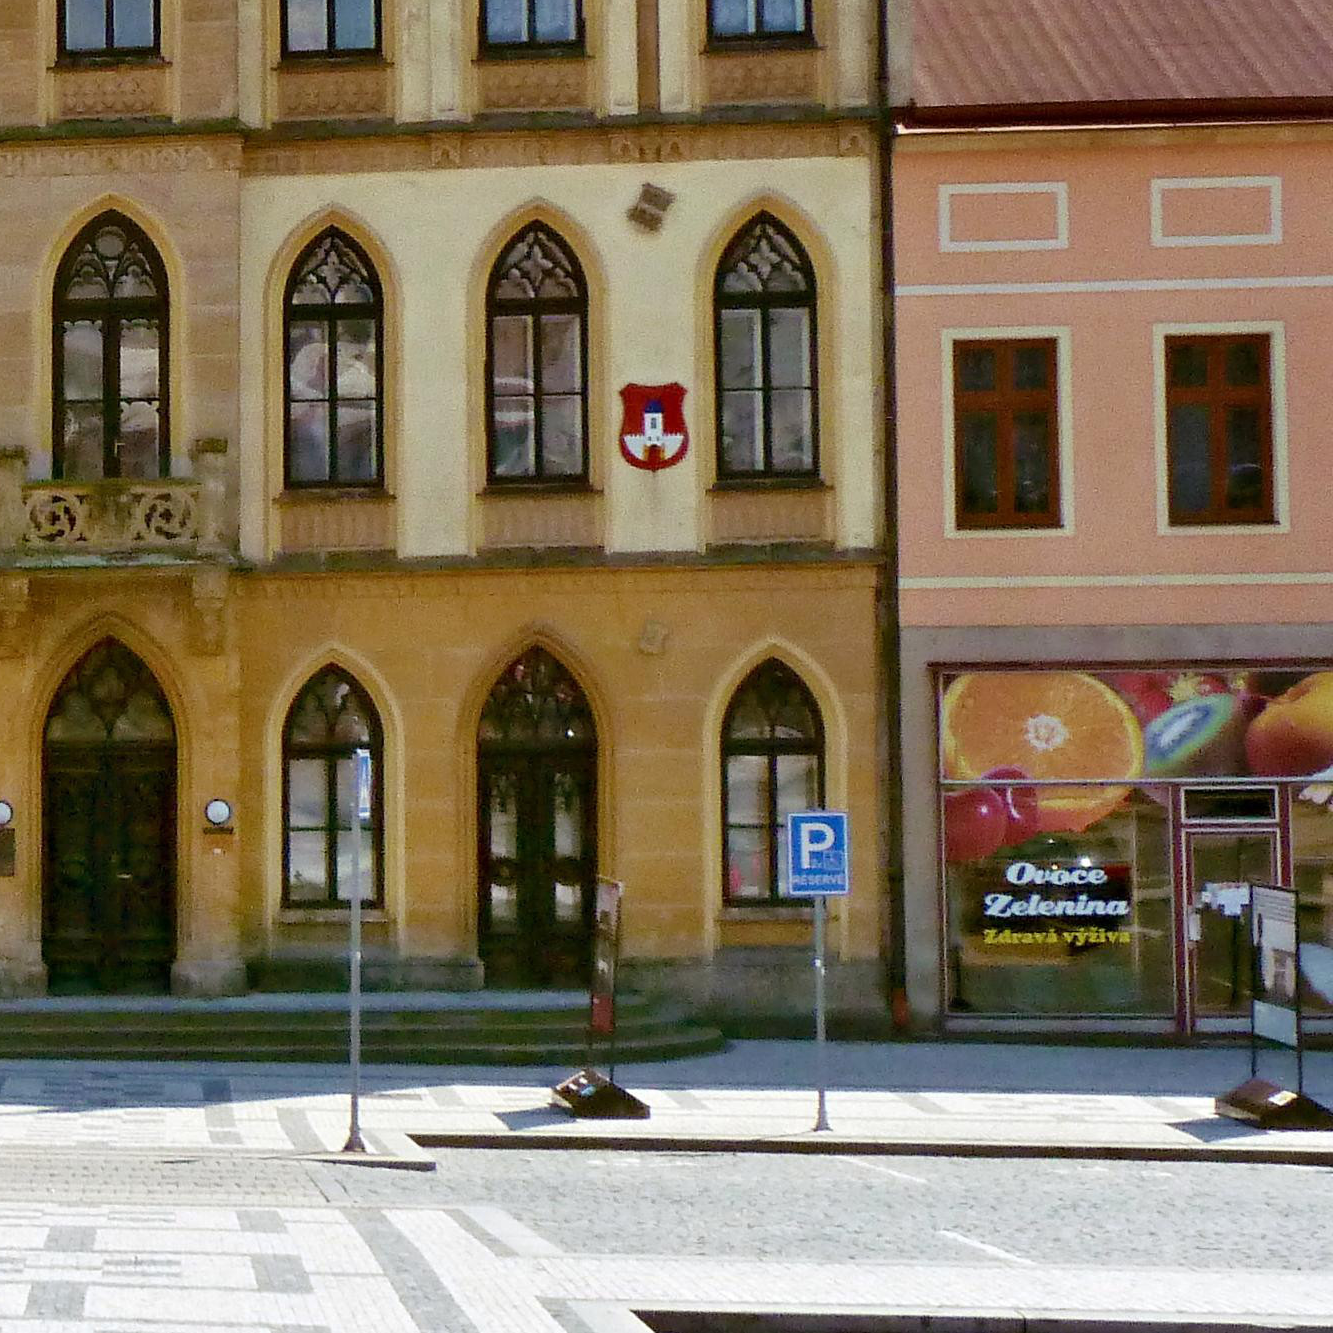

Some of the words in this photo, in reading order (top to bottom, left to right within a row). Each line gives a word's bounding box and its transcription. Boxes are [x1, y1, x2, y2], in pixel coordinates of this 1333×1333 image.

[800, 822, 836, 869] P
[1006, 862, 1108, 885] Ovoce
[984, 893, 1129, 917] Zelenina
[983, 928, 1058, 945] Zdravá
[1062, 927, 1132, 946] výživa
